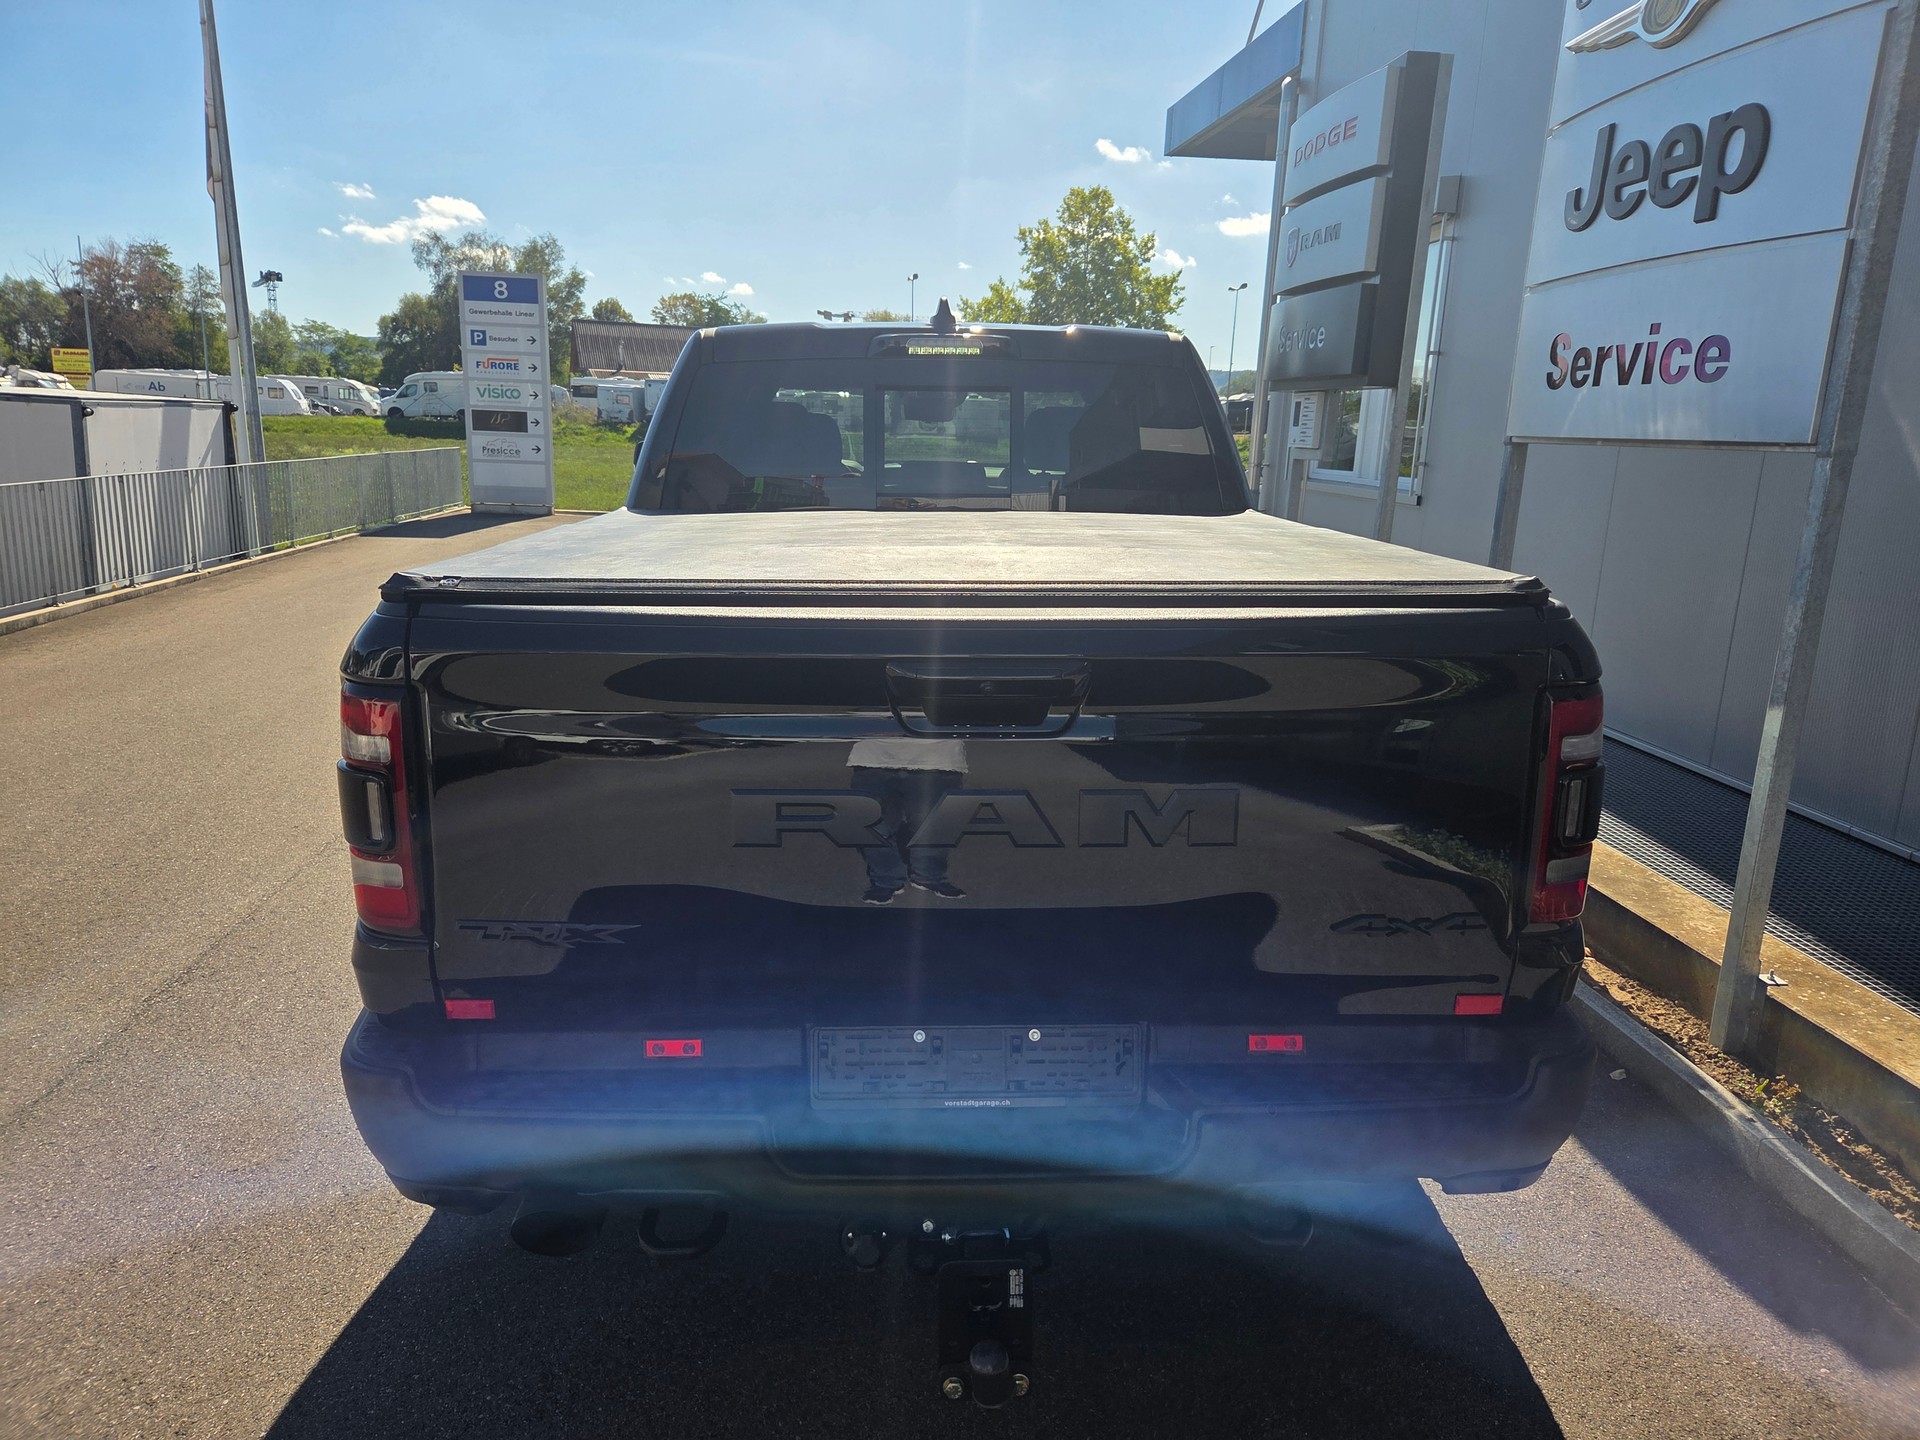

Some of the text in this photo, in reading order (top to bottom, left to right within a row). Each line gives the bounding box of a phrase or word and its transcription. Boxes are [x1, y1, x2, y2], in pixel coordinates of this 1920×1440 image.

[1293, 115, 1358, 168] DODGE
[1564, 102, 1771, 233] Jeep
[1300, 221, 1342, 251] RAM
[494, 280, 508, 299] 8
[468, 308, 513, 317] Gewerbehalle
[474, 332, 484, 343] P
[1278, 320, 1326, 354] Service
[476, 358, 520, 371] FURORE
[1546, 322, 1731, 390] Service
[482, 446, 521, 456] Presicce
[730, 788, 1241, 849] RAM
[456, 919, 642, 949] TRX
[944, 1099, 1011, 1107] vorstadtgarage.ch
